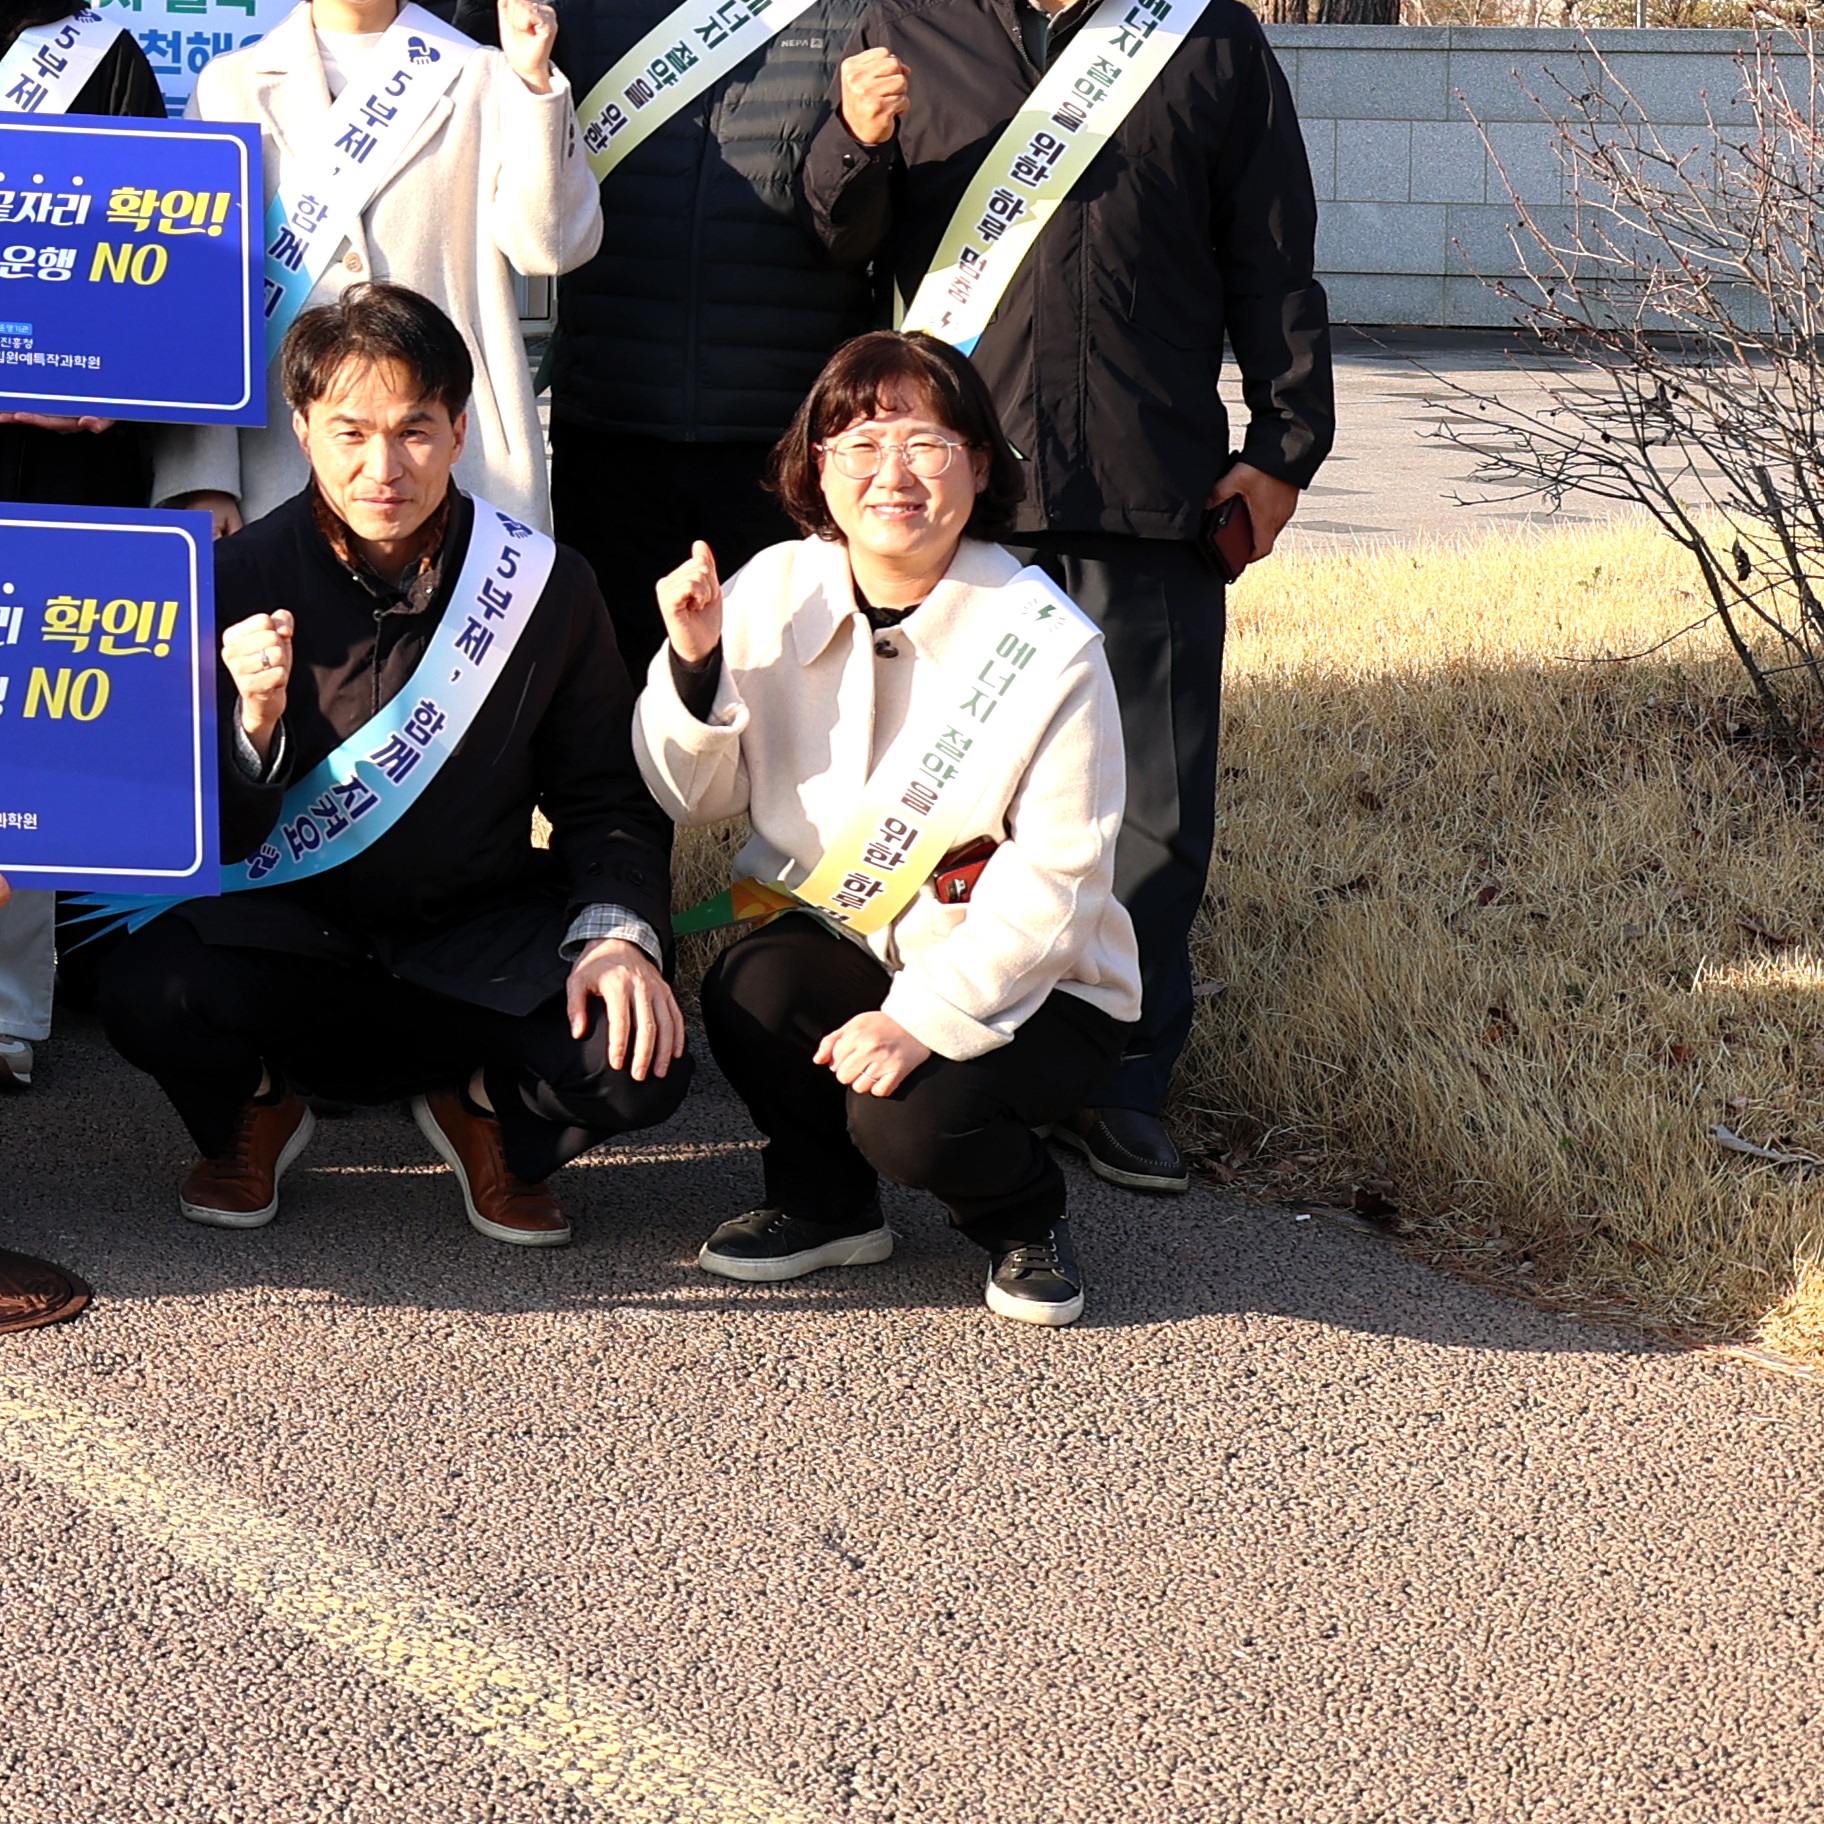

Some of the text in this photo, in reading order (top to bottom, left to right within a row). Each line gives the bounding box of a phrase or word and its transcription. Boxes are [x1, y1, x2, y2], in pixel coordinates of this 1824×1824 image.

[780, 39, 809, 48] NEPA
[623, 40, 700, 109] 절약을
[1051, 55, 1123, 134] 절약을
[584, 103, 629, 154] 위한
[268, 69, 413, 272] 5부제, 함께
[1011, 132, 1066, 187] 위한
[106, 186, 231, 237] 확인!
[977, 188, 1025, 242] 하루
[88, 241, 168, 286] NO
[947, 246, 988, 304] 멈춤
[41, 595, 179, 658] 확인!
[23, 666, 110, 721] NO
[282, 544, 521, 862] 5부제, 함께 지켜요
[958, 632, 1037, 724] 에너지
[900, 724, 974, 817] 절약을
[863, 817, 919, 872] 위한
[831, 872, 885, 911] 하루
